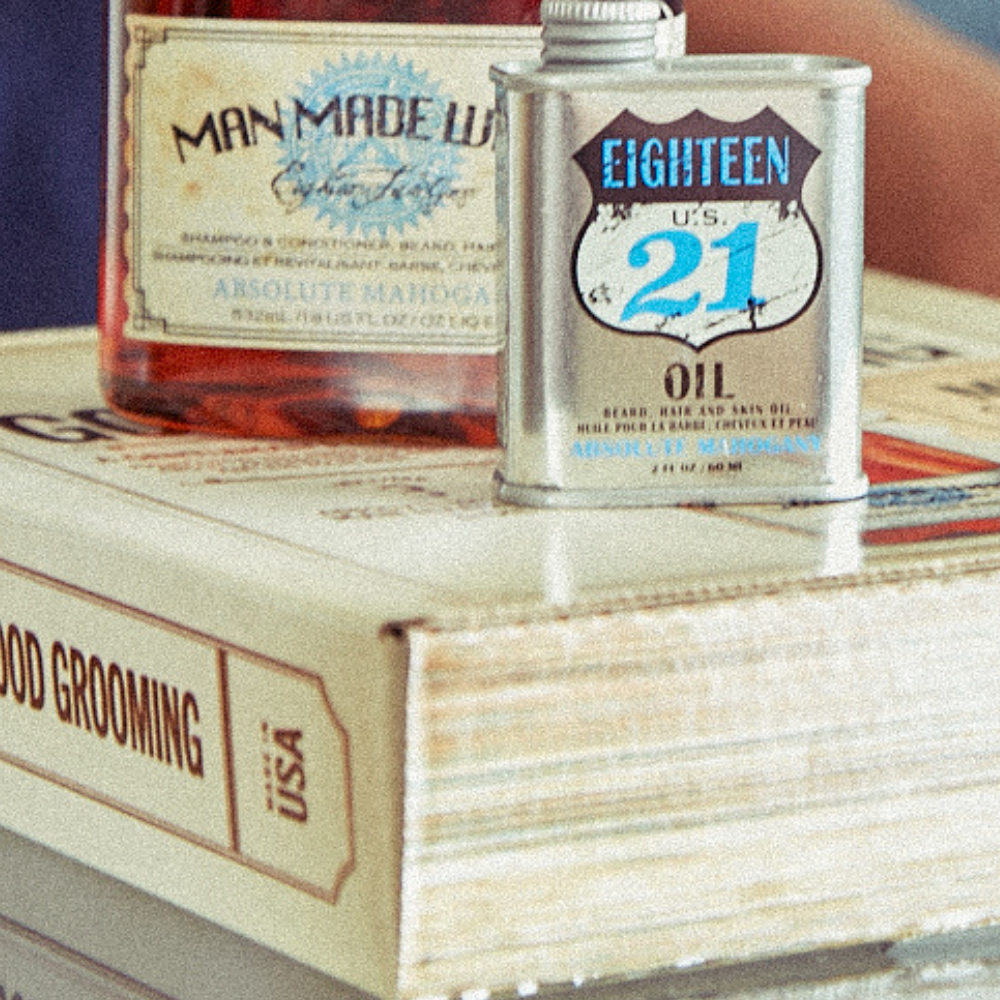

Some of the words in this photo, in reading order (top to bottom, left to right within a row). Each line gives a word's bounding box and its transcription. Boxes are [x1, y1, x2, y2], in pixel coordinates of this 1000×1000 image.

[171, 100, 284, 164] MAN
[294, 95, 433, 141] MADE
[443, 102, 498, 150] W
[602, 136, 790, 189] EIGHTEEN
[214, 277, 351, 302] ABSOLUTE
[619, 222, 767, 322] 21
[664, 362, 735, 400] OIL
[576, 422, 609, 434] HUILE
[652, 420, 665, 432] LA
[771, 417, 784, 429] ET
[660, 405, 692, 417] HAIR
[732, 403, 764, 415] SKIN
[770, 402, 791, 414] OIL
[570, 437, 688, 459] ABSOLUTE
[698, 432, 821, 456] MAHOGANY
[52, 640, 204, 778] GROOMING
[273, 728, 307, 823] USA
